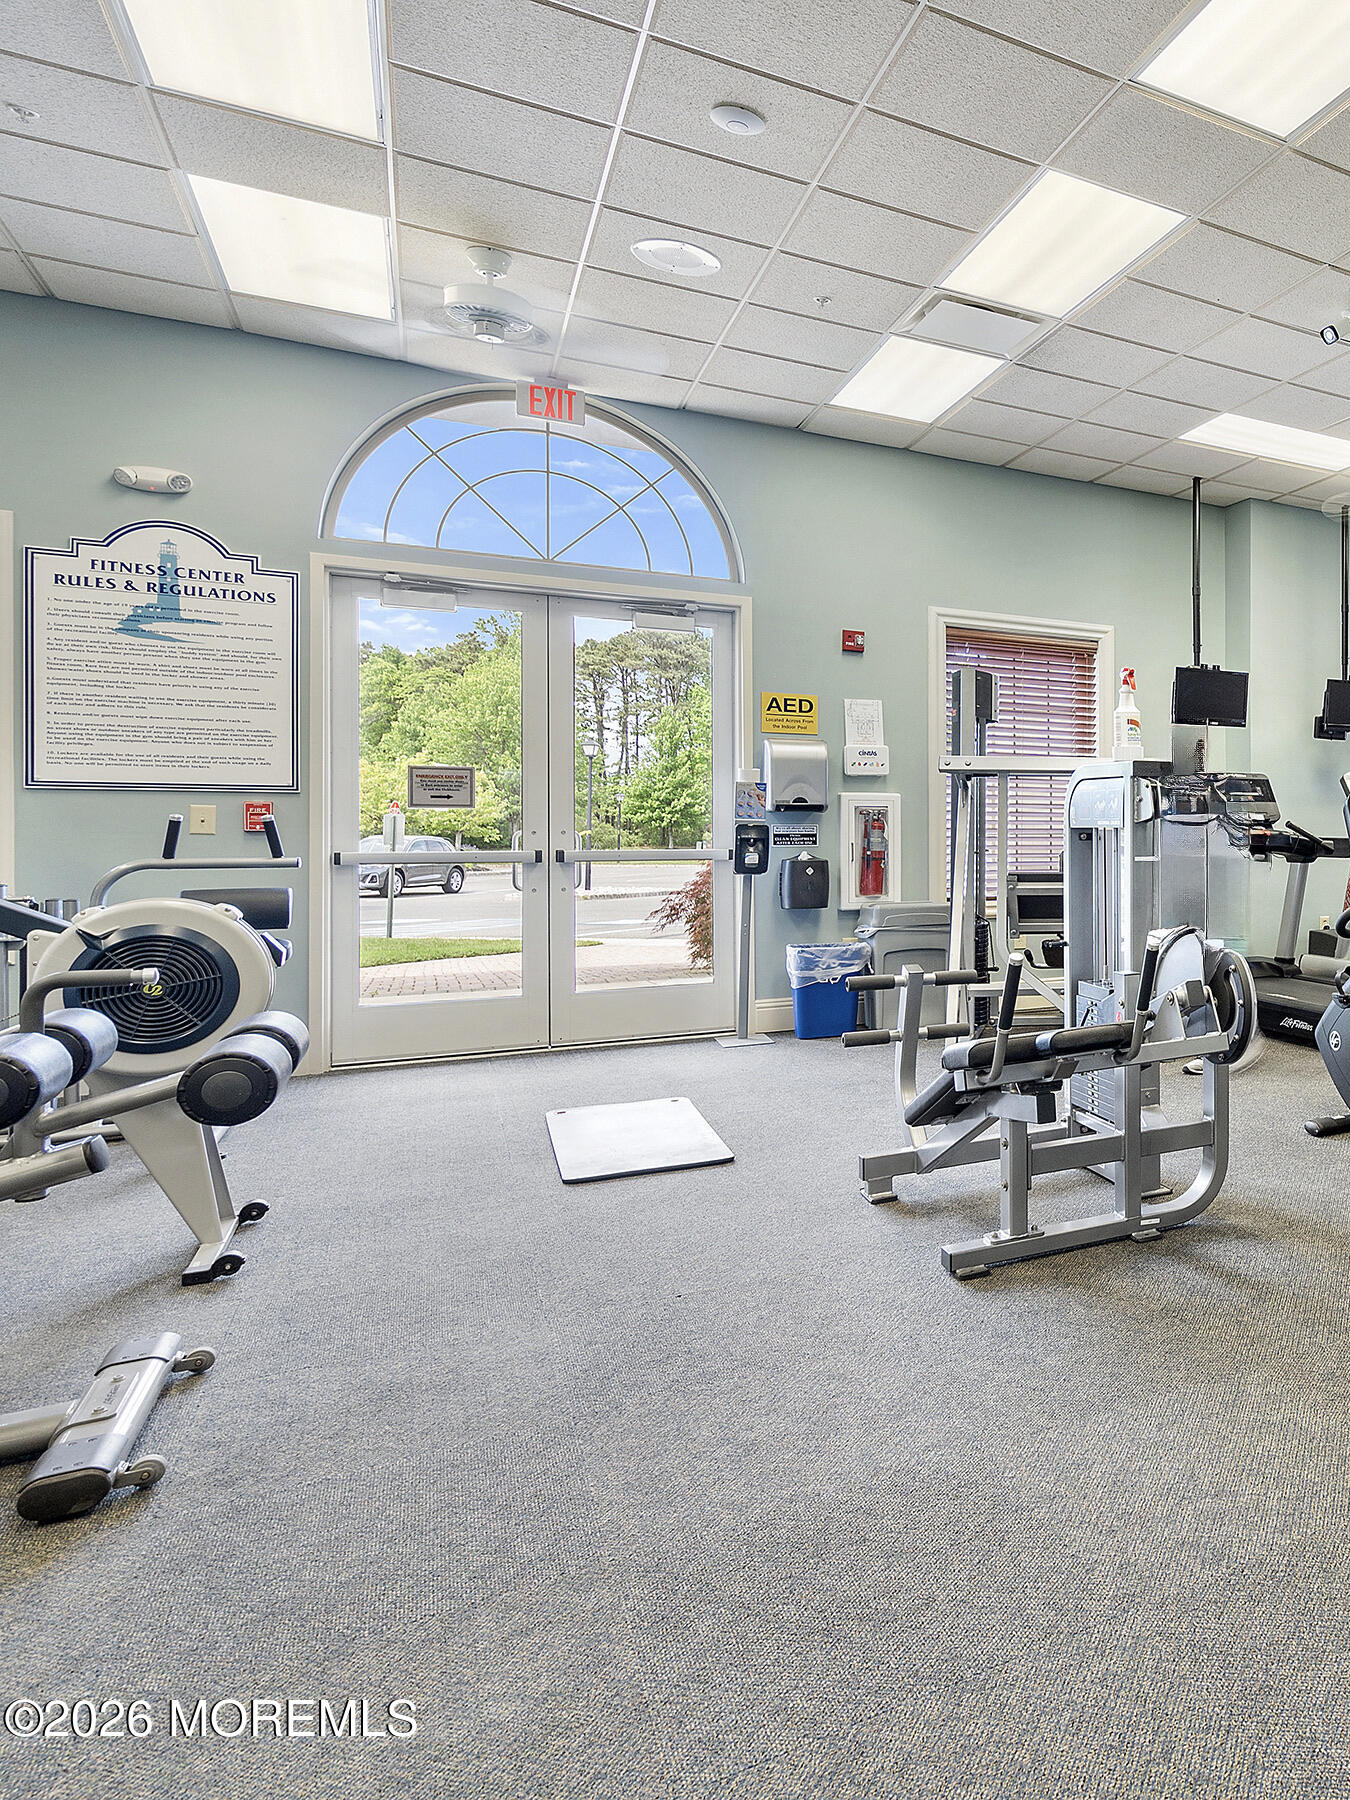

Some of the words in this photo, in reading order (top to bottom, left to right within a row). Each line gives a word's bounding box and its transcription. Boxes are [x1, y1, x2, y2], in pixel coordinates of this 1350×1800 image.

[528, 384, 577, 422] EXIT
[90, 558, 168, 576] FITNESS
[174, 567, 246, 584] CENTER
[54, 574, 116, 590] RULES
[124, 578, 140, 592] &
[146, 582, 277, 604] REGULATIONS
[766, 697, 814, 714] AED
